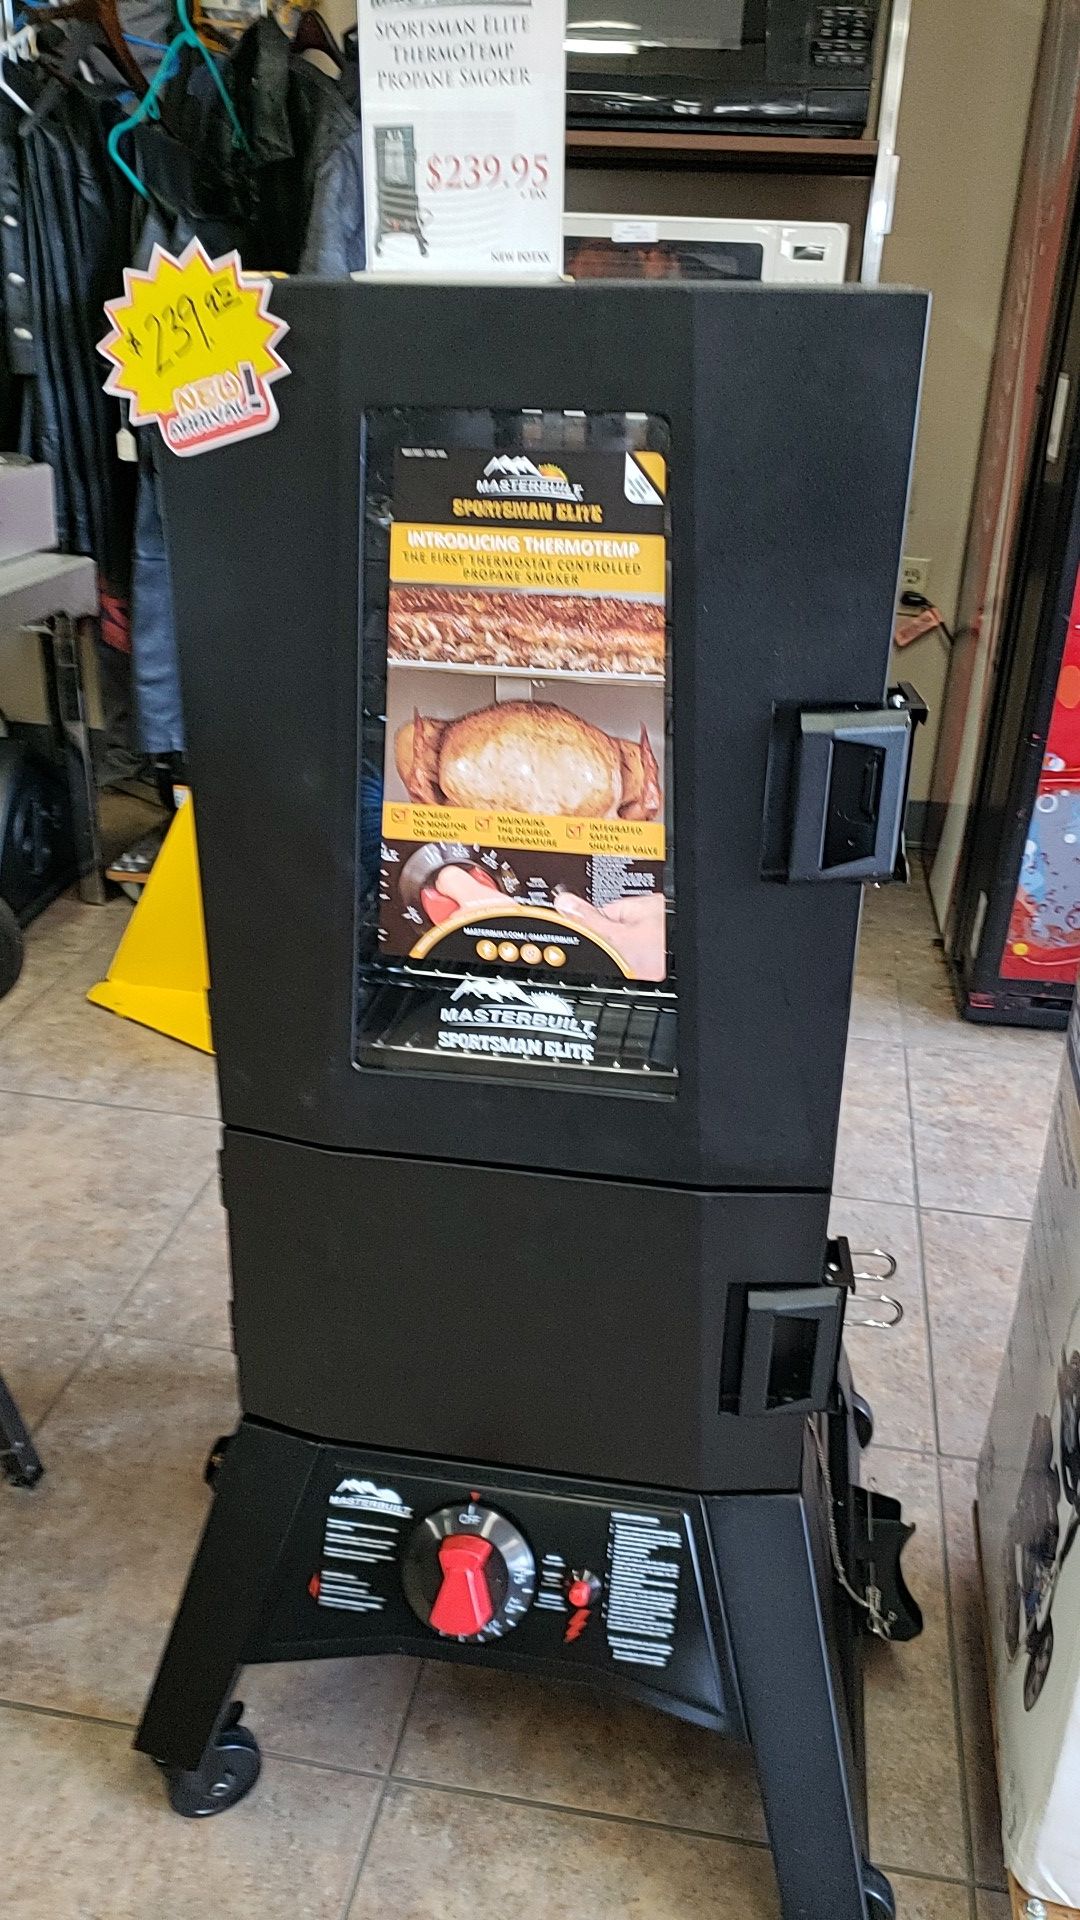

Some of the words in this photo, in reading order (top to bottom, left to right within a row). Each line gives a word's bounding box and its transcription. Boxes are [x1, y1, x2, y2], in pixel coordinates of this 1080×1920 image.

[375, 17, 476, 41] SPORTSMAN
[483, 13, 529, 35] ELITE
[377, 69, 452, 91] PROPANE
[460, 66, 532, 88] SMOKER
[426, 153, 548, 191] $239.95
[173, 371, 243, 417] NEW
[452, 498, 553, 522] SPORTSMAN
[556, 502, 603, 523] ELITE
[408, 529, 520, 553] INTRODUCING
[525, 535, 640, 559] THERMOTEMP
[402, 551, 428, 564] THE
[431, 552, 465, 566] FIRST
[471, 553, 552, 572] THERMOSTAT
[558, 559, 642, 576] CONTROLLED
[463, 568, 521, 584] PROPANE
[526, 571, 580, 586] SMOKER
[440, 1008, 597, 1041] MASTERBUILT
[438, 1031, 543, 1057] SPORTSMAN
[544, 1040, 595, 1062] ELITE
